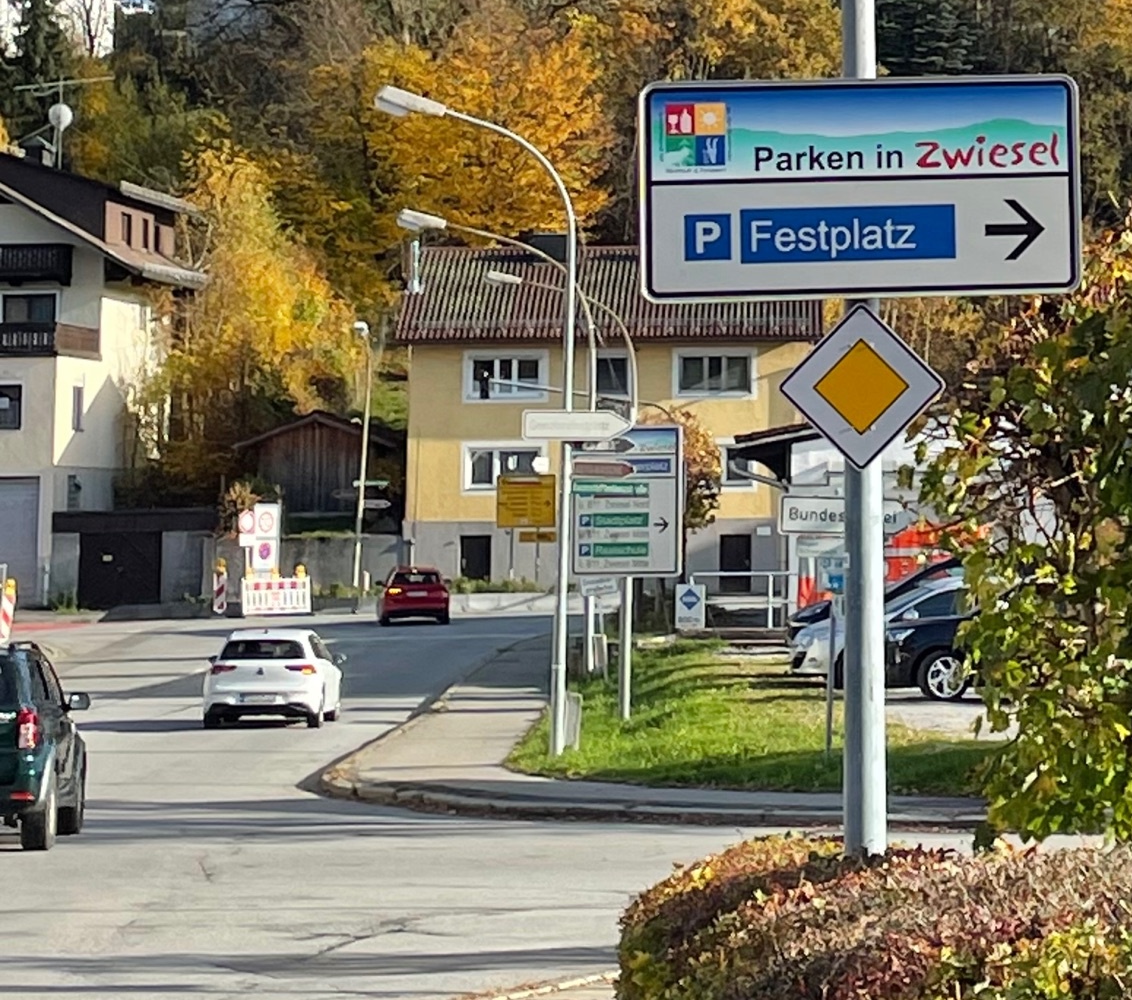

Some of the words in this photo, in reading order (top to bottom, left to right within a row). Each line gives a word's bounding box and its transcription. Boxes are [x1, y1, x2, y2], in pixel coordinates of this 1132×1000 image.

[753, 145, 865, 172] Parken
[876, 143, 904, 170] in
[914, 133, 1060, 171] Zwiesel
[694, 221, 722, 254] P
[749, 217, 917, 259] Festplatz
[788, 506, 897, 523] Bundesei
